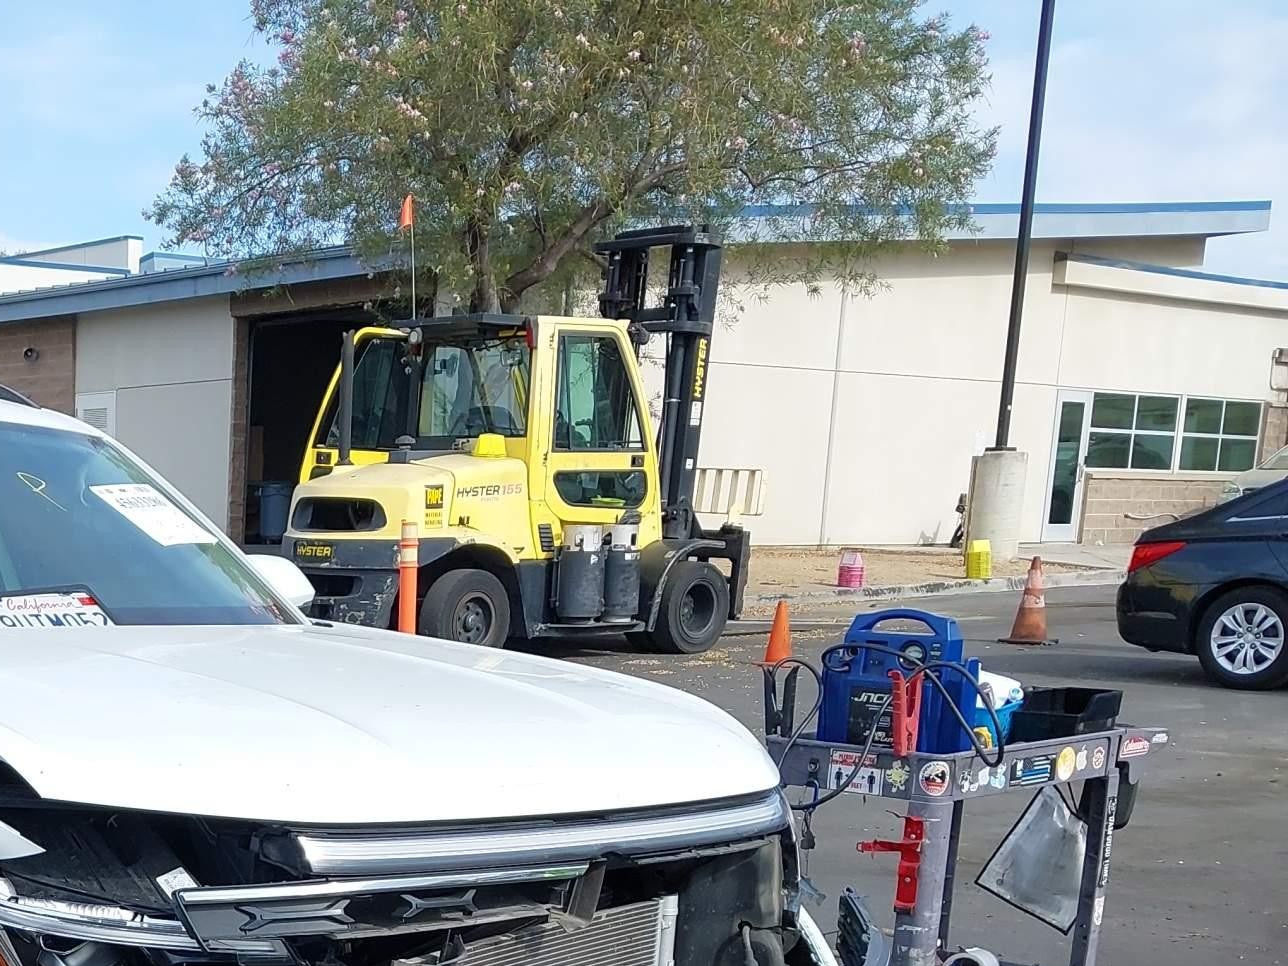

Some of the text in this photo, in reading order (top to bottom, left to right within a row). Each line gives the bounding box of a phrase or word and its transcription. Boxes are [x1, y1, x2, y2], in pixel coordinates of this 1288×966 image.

[694, 338, 708, 398] HYSTER
[457, 483, 523, 498] HYSTER 155
[296, 545, 331, 557] HYSTER
[6, 598, 73, 613] California
